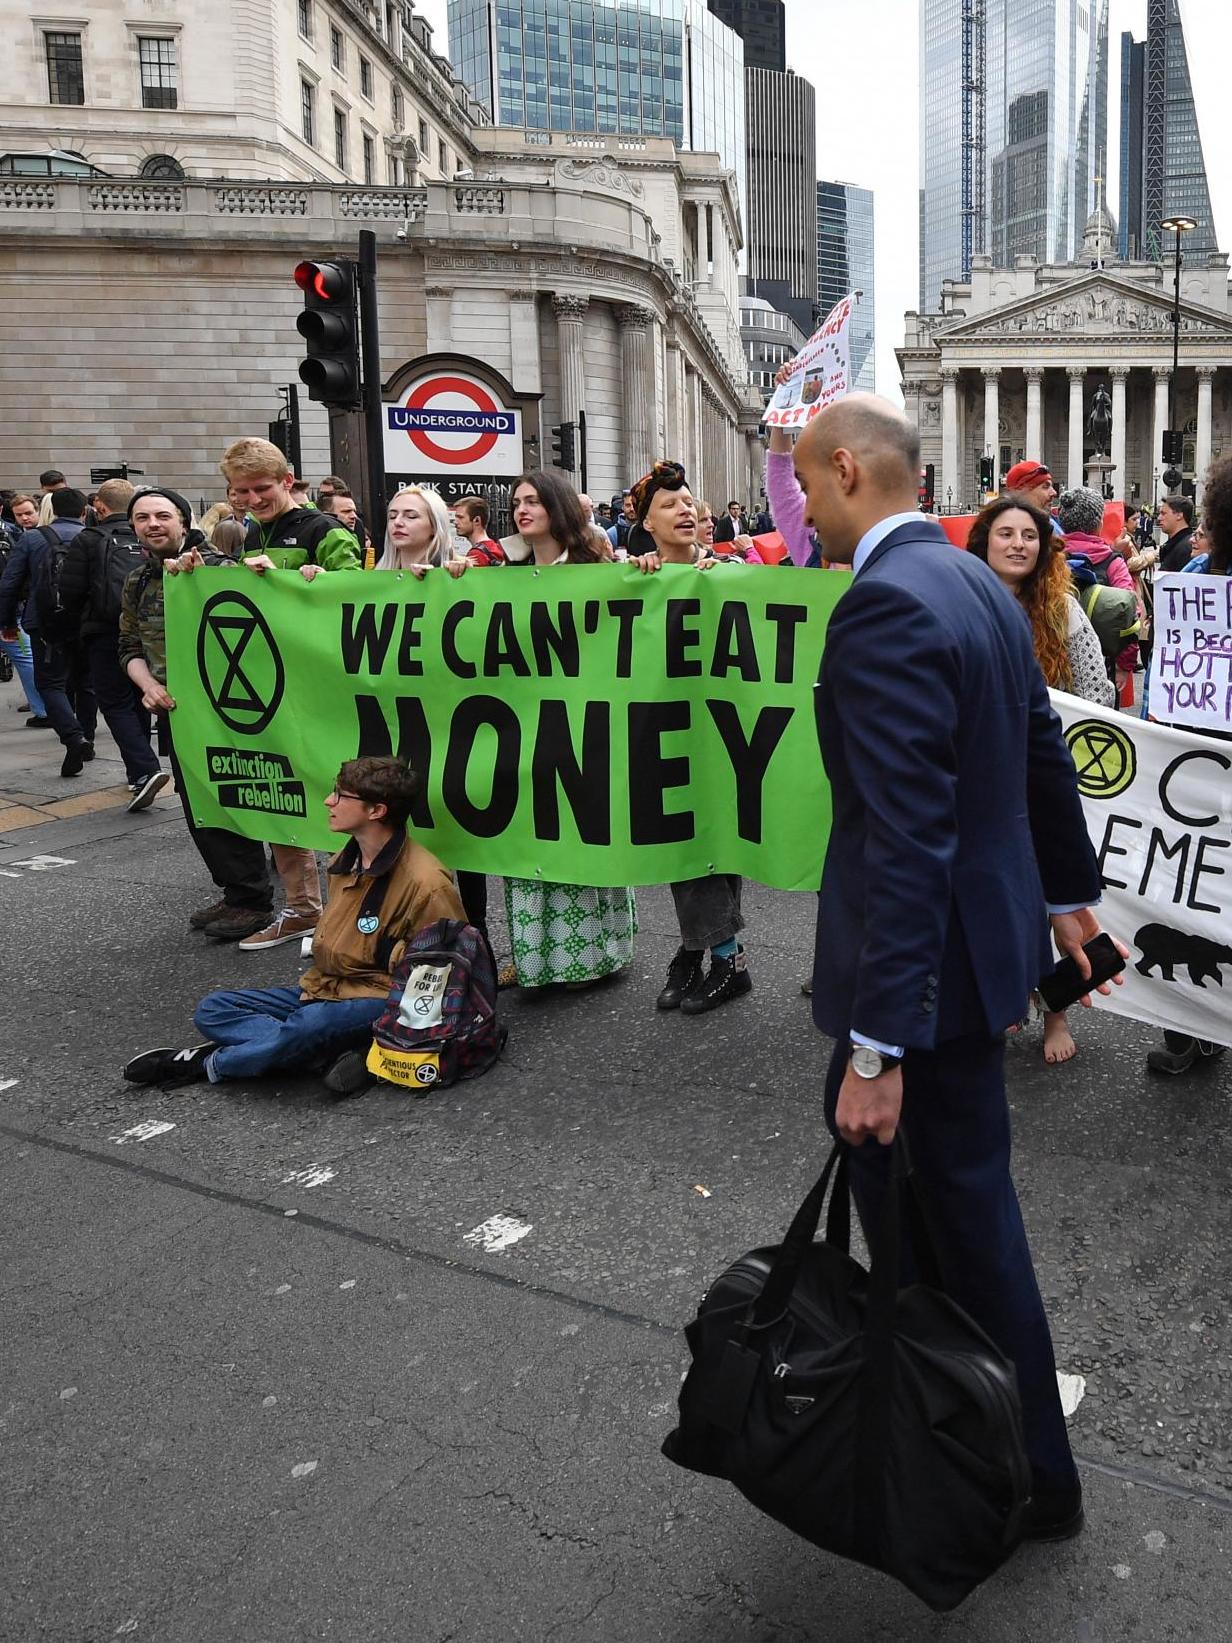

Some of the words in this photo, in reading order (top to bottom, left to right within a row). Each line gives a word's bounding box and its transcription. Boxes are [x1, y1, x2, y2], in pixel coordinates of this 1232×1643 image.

[394, 411, 509, 430] UNDERGROUND
[767, 408, 804, 424] ACT
[448, 482, 512, 495] STATION
[1162, 587, 1217, 621] THE
[341, 602, 426, 676] WE
[441, 599, 644, 679] CAN'T
[666, 598, 807, 684] EAT
[1166, 628, 1182, 644] IS
[1162, 682, 1218, 714] YOUR
[211, 751, 284, 780] extinction
[354, 694, 796, 846] MONEY
[237, 781, 304, 813] rebellion
